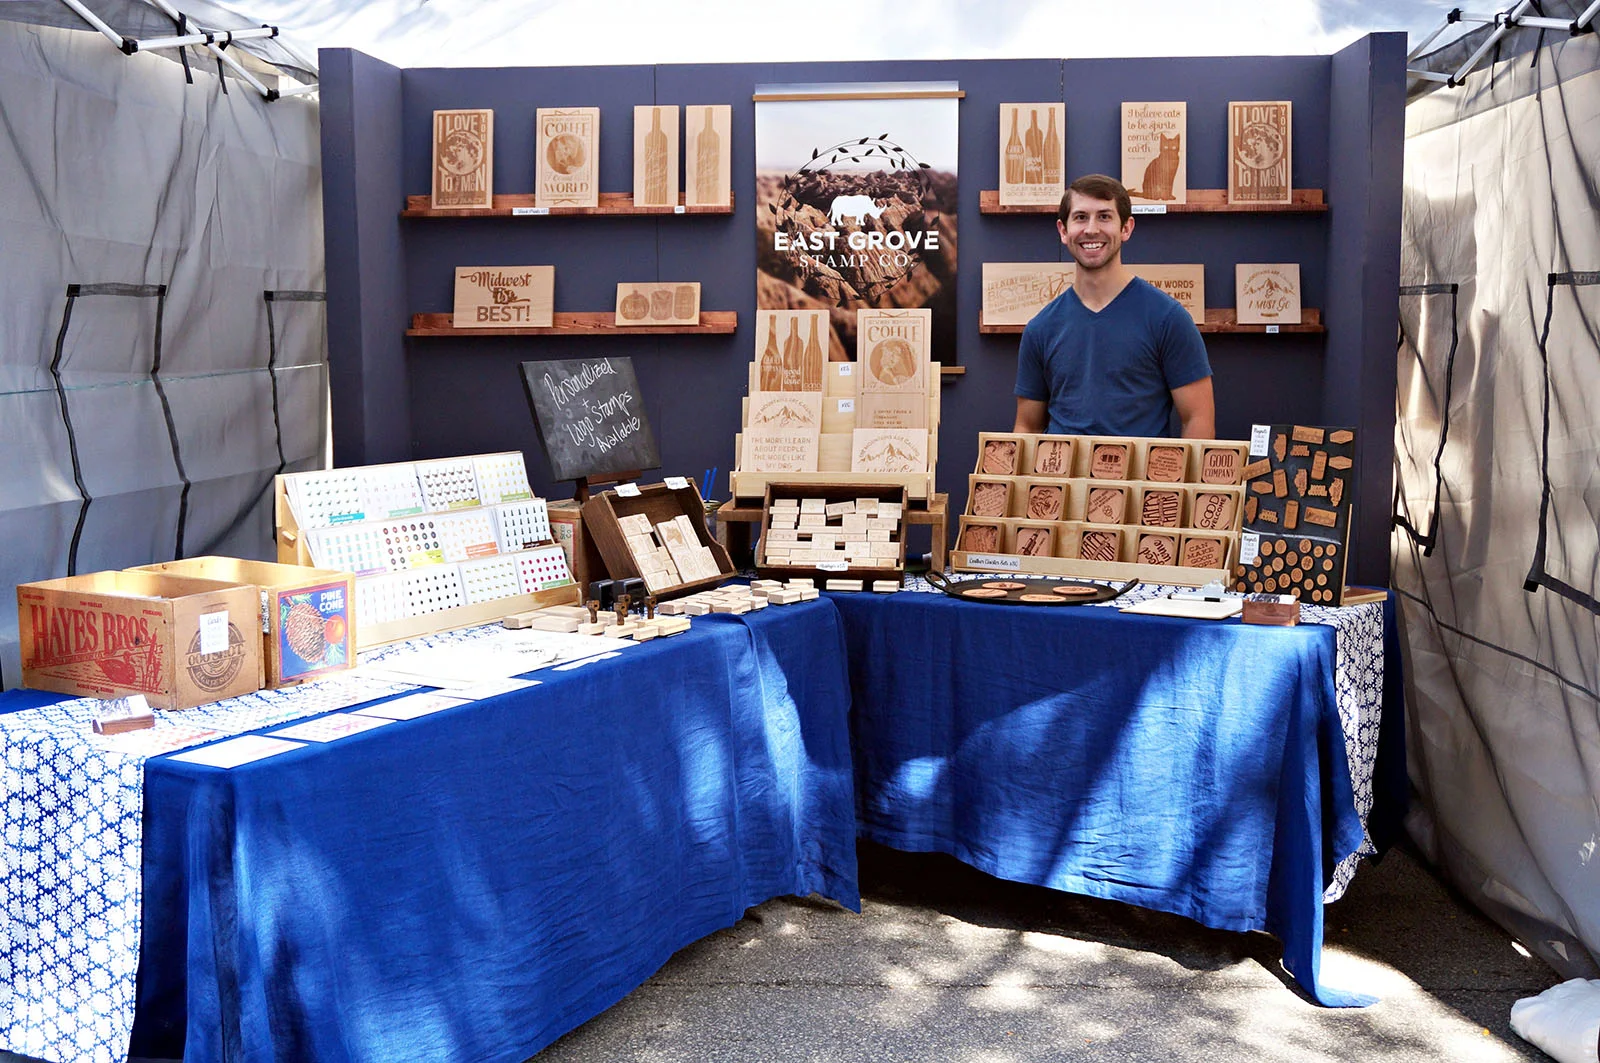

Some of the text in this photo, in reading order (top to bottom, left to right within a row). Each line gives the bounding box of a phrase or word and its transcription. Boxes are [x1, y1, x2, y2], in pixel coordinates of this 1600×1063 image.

[438, 115, 443, 143] I
[445, 114, 479, 136] LOVE
[1234, 107, 1240, 136] I
[1242, 107, 1278, 129] LOVE
[1127, 142, 1152, 153] earth
[438, 166, 453, 192] TO
[1235, 159, 1252, 188] TO
[543, 183, 589, 193] WORLD
[774, 230, 940, 250] EAST GROVE
[799, 254, 914, 268] STAMP CO.
[460, 271, 532, 292] Midwest
[1164, 280, 1194, 289] WORDS
[1174, 291, 1192, 300] MEN
[1256, 299, 1277, 309] MUST
[476, 305, 530, 322] BEST!
[544, 357, 618, 411] Personalized
[591, 391, 632, 424] Stamps
[596, 416, 640, 453] Available
[1209, 454, 1233, 468] GOOD
[1204, 467, 1235, 479] COMPANY
[1142, 495, 1160, 525] HAPPY
[1162, 495, 1178, 523] HOUR
[1200, 495, 1219, 528] GOOD
[1210, 498, 1226, 529] WELCOME
[1081, 531, 1108, 560] HAPPY
[1154, 540, 1172, 562] wine
[1187, 547, 1214, 559] MAKE
[1189, 542, 1208, 552] CAN
[1191, 553, 1214, 564] GOOD
[319, 599, 344, 612] CONE
[320, 590, 342, 602] PINE
[30, 604, 152, 665] HAYES BROS.
